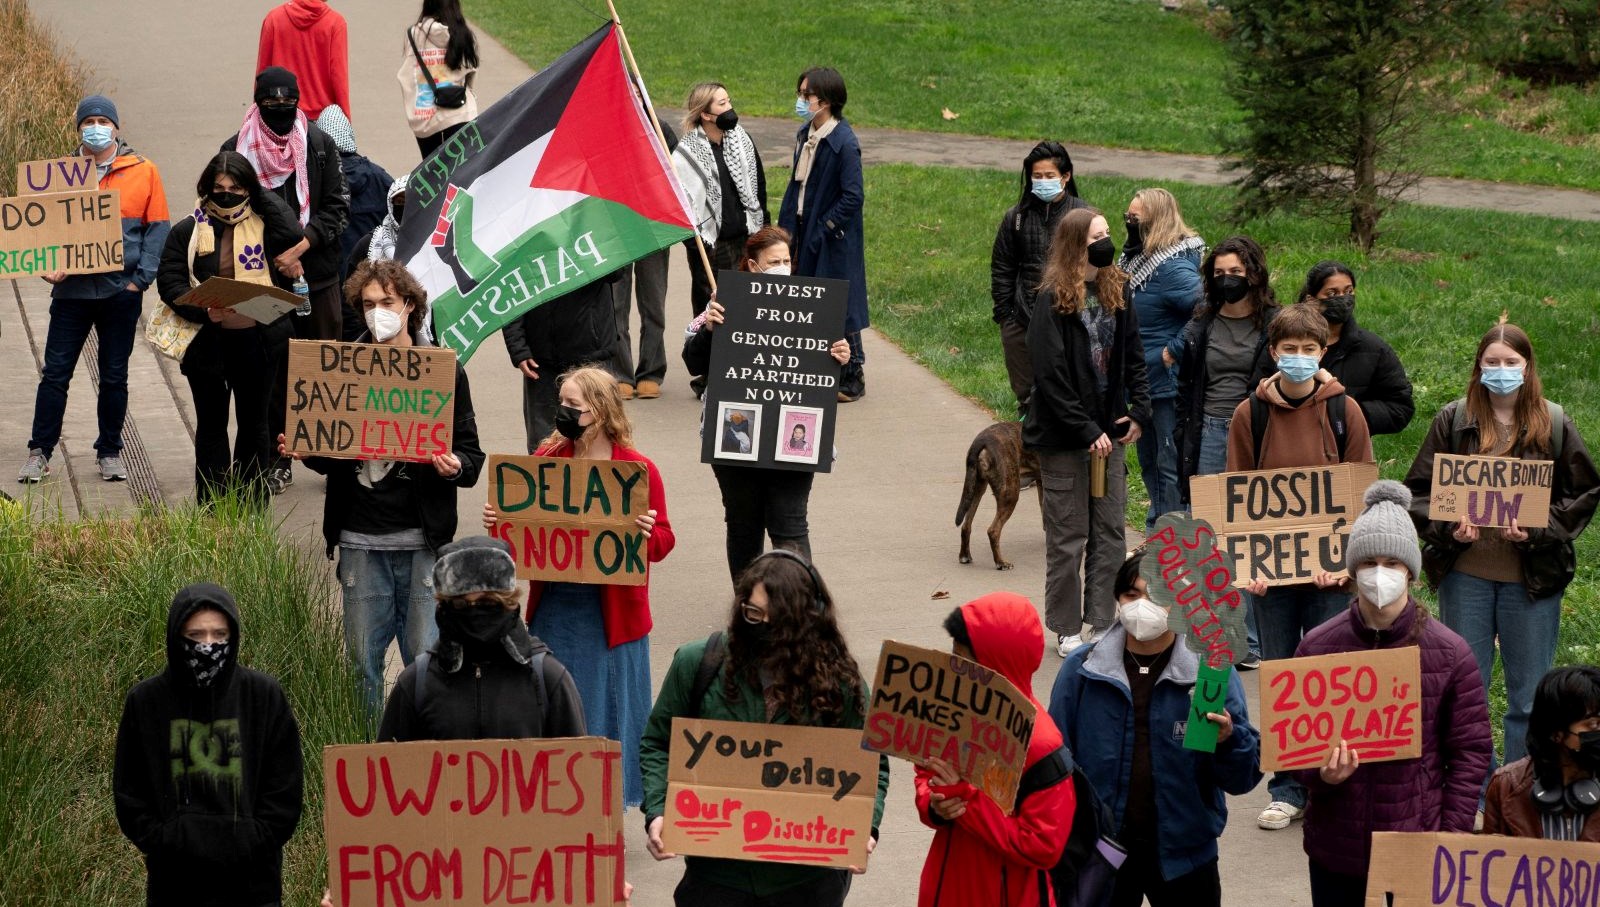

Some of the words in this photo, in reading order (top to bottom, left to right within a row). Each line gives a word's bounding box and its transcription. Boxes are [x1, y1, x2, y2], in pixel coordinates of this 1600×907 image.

[26, 158, 92, 191] UW
[2, 201, 46, 231] DO
[57, 193, 112, 225] THE
[0, 245, 60, 275] RIGHT
[62, 239, 123, 270] THING
[250, 260, 261, 269] W
[750, 281, 826, 299] DIVEST
[755, 307, 814, 324] FROM
[731, 331, 828, 352] GENOCIDE
[752, 352, 800, 369] AND
[320, 344, 432, 381] DECARB:
[725, 366, 836, 388] APARTHEID
[364, 385, 453, 419] MONEY
[745, 387, 803, 404] NOW!
[292, 418, 355, 452] AND
[360, 419, 449, 456] LIVES
[496, 461, 642, 517] DELAY
[1226, 469, 1346, 523] FOSSIL
[1467, 490, 1524, 527] UW
[523, 525, 590, 572] NOT
[593, 529, 646, 576] OK
[1182, 526, 1241, 609] STOP
[1226, 531, 1312, 582] FREE
[1147, 525, 1235, 668] POLLUTING
[883, 653, 1034, 752] POLLUTION
[1270, 665, 1378, 713] 2050
[1392, 676, 1410, 700] is
[867, 711, 988, 779] SWEAT
[873, 688, 964, 732] MAKES
[970, 714, 1018, 766] YOU
[1270, 711, 1335, 751] TOO
[1341, 702, 1419, 742] LATE
[761, 757, 861, 802] Delay
[675, 789, 743, 820] Our
[743, 810, 856, 846] Disaster
[338, 843, 464, 907] FROM
[483, 830, 625, 905] DEATH
